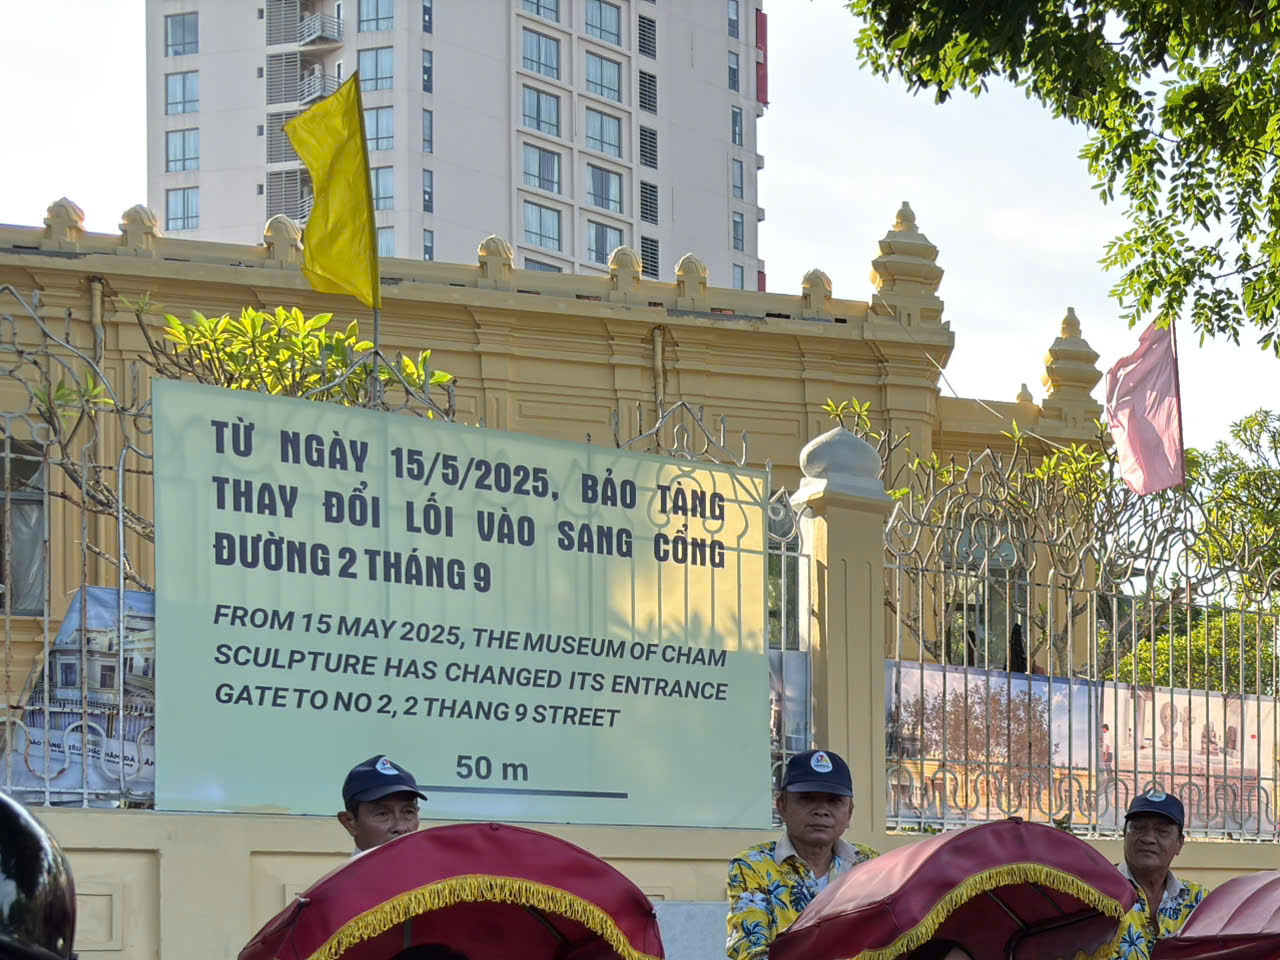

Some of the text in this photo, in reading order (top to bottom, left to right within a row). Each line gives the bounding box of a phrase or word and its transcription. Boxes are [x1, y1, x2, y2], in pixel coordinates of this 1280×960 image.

[211, 416, 725, 522] TỪ NGÀY 15/5/2025, BẢO TÀNG
[212, 476, 725, 569] THAY ĐỔI LỐI VÀO SANG CỔNG
[213, 531, 491, 593] ĐƯỜNG 2 THÁNG 9
[213, 604, 728, 667] FROM 15 MAY 2025, THE MUSEUM OF CHAM
[214, 643, 729, 701] SCULPTURE HAS CHANGED ITS ENTRANCE
[215, 683, 621, 728] GATE TO NO 2, 2 THANG 9 STREET
[455, 755, 528, 781] 50 m
